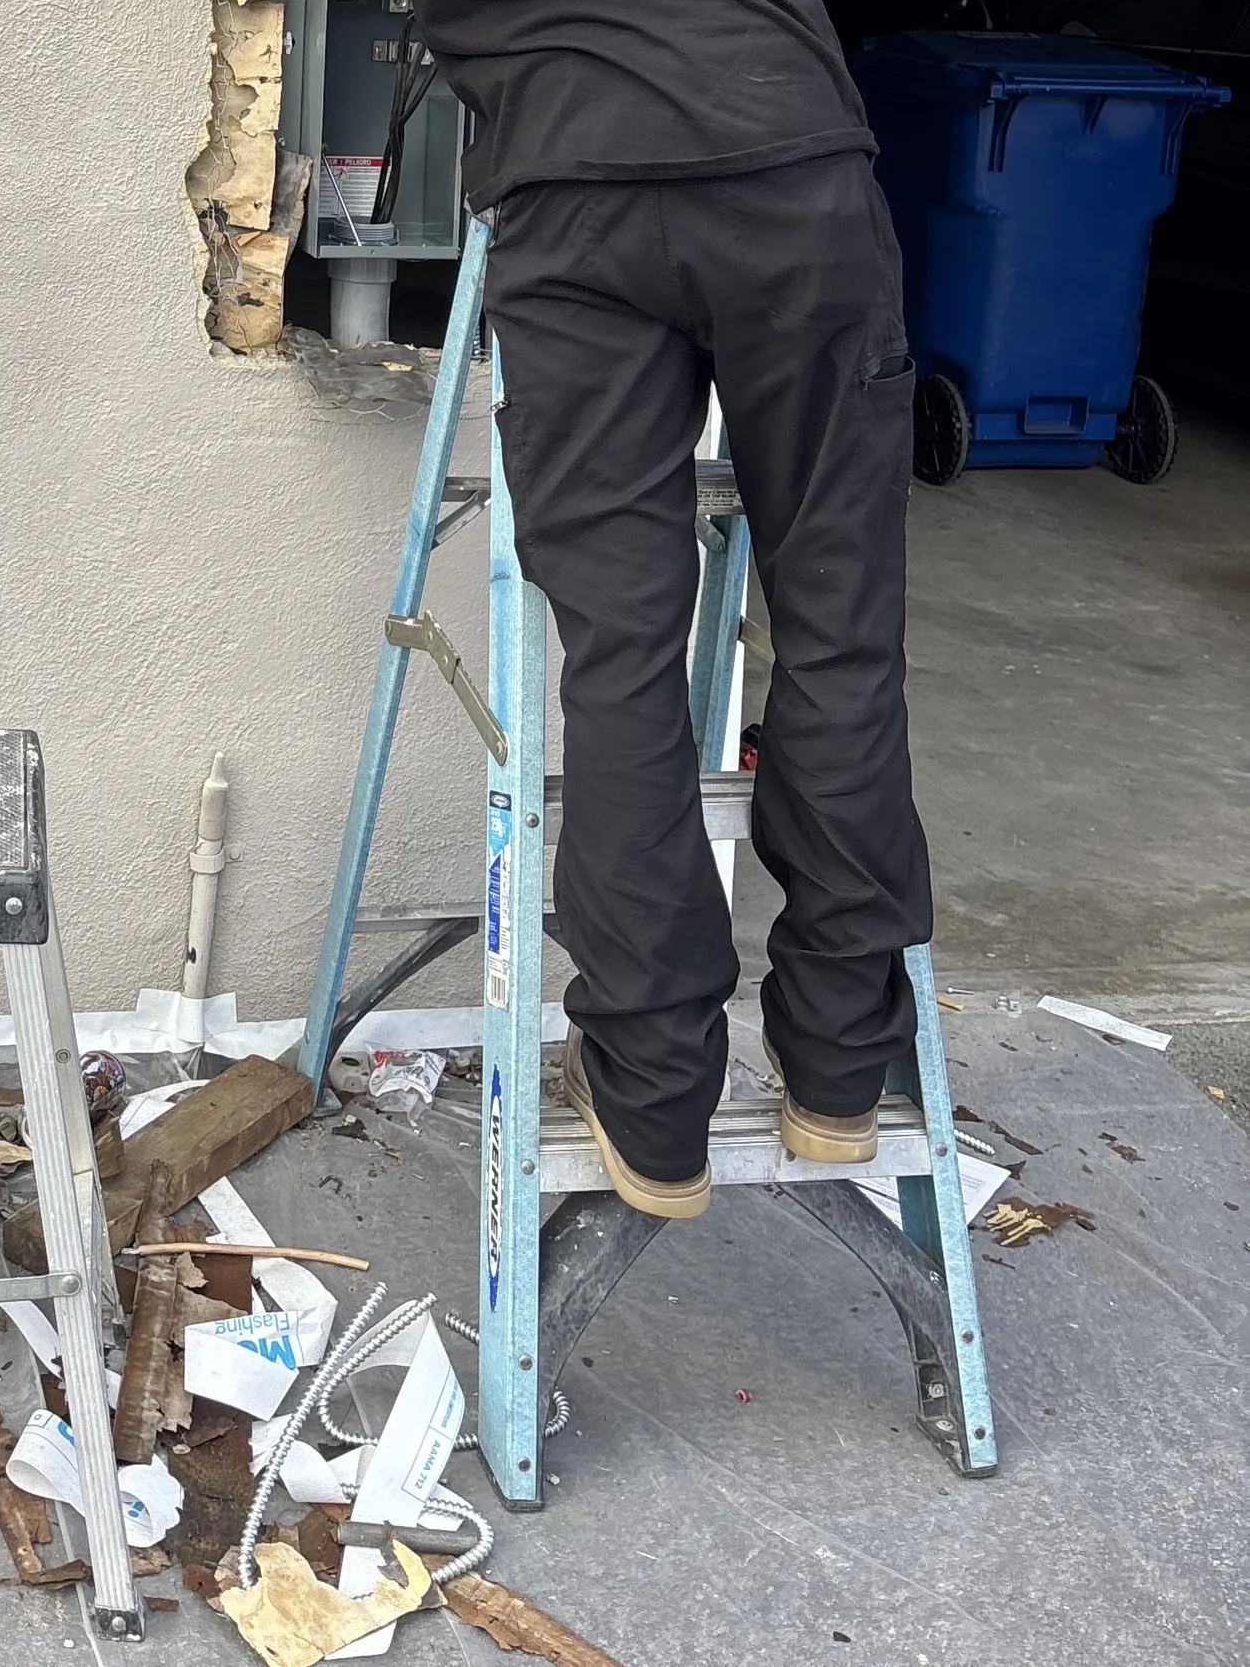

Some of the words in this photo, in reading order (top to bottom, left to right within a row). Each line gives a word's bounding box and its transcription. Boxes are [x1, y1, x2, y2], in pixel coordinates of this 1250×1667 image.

[490, 1114, 500, 1263] WERNER
[215, 1311, 291, 1336] Flashing
[423, 1439, 441, 1472] AAMA
